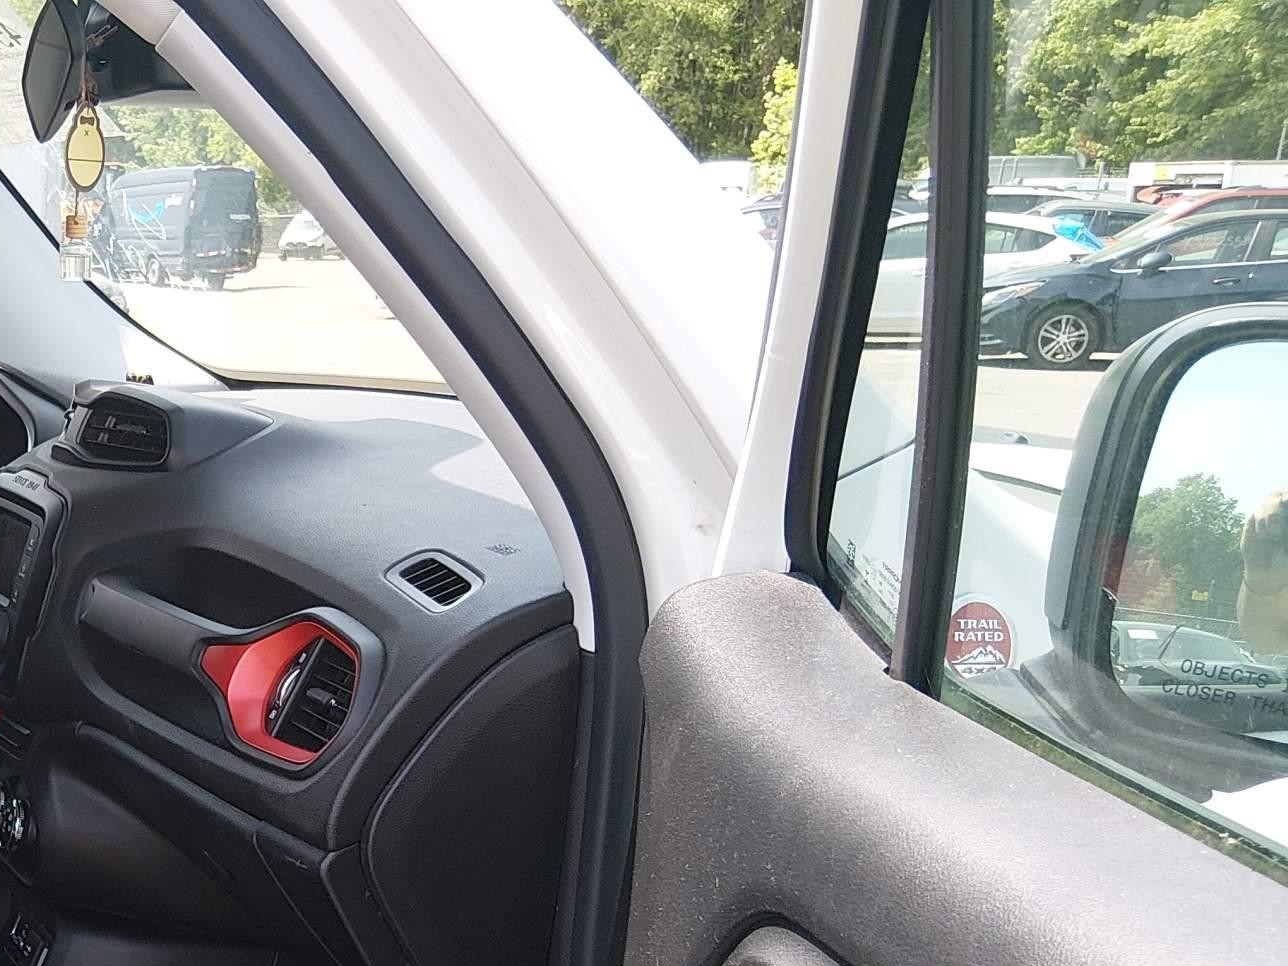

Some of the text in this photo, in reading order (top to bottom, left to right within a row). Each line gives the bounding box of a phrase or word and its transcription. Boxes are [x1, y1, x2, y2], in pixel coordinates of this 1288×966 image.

[957, 619, 1002, 629] TRAIL
[954, 631, 1004, 642] RATED
[1180, 659, 1270, 689] OBJECTS
[1162, 679, 1237, 706] CLOSER
